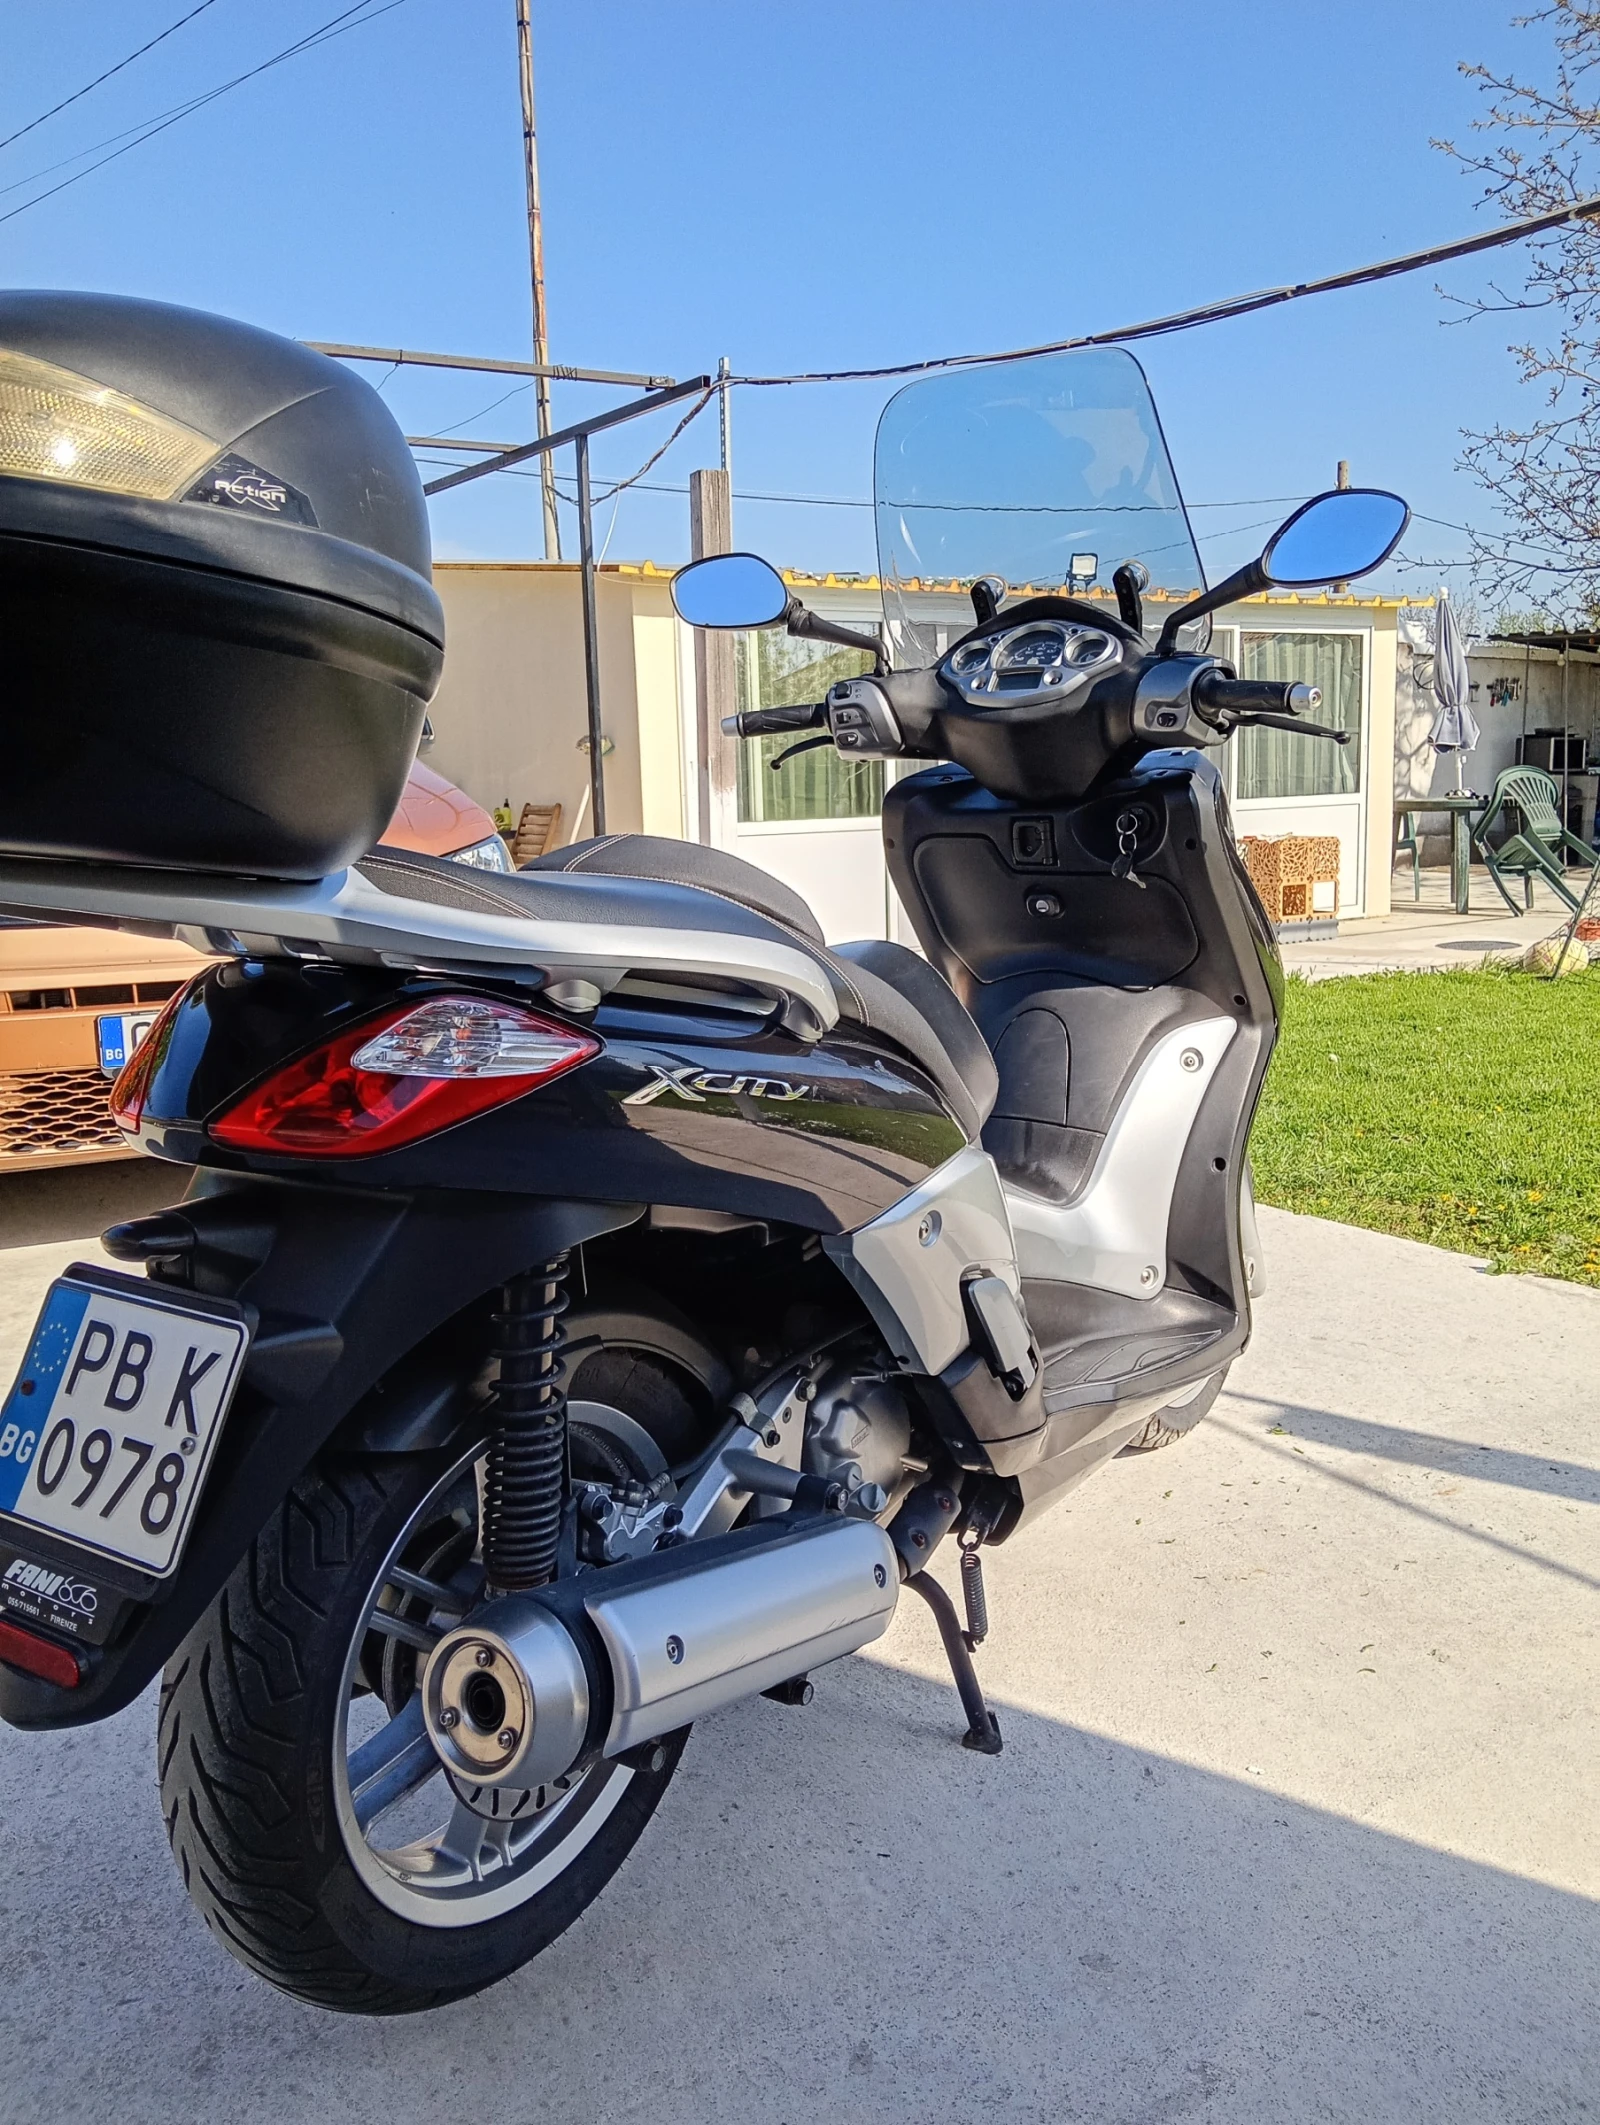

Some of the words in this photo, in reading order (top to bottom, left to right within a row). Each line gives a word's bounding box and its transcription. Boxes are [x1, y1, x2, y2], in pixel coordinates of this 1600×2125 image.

[105, 1048, 123, 1061] BG
[0, 1423, 36, 1464] BG
[36, 1418, 185, 1536] 0978
[4, 1559, 65, 1596] FANI
[50, 1614, 78, 1632] FIRENZE
